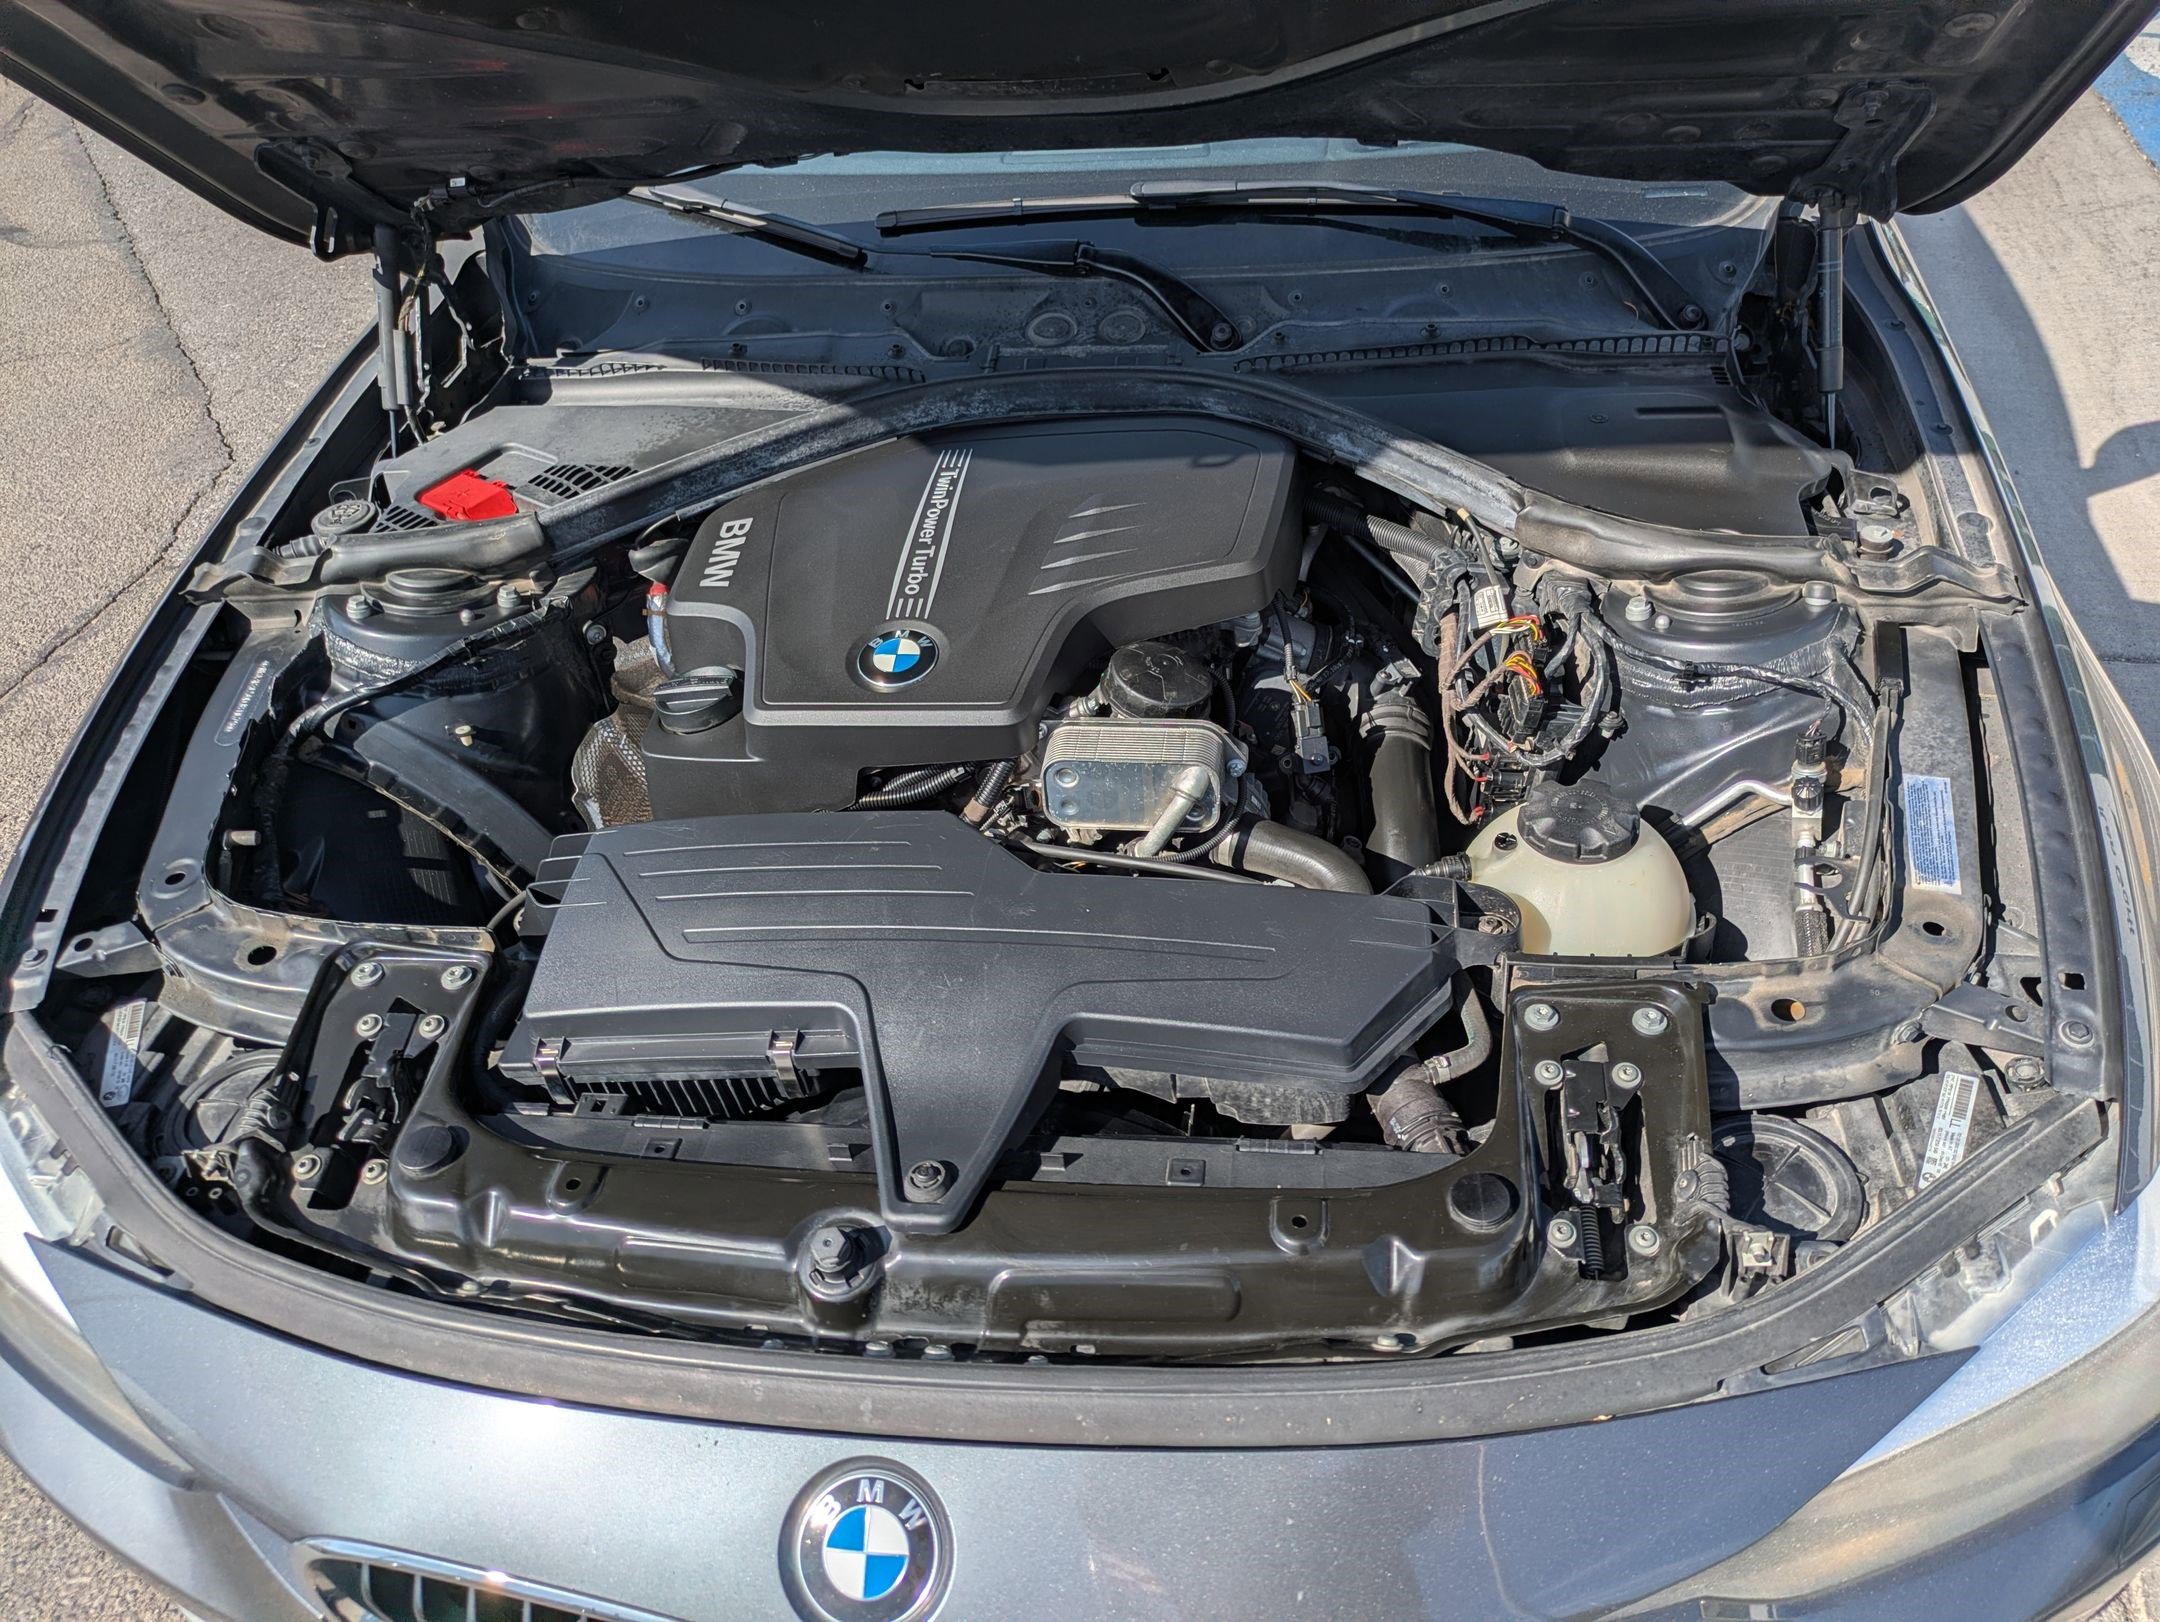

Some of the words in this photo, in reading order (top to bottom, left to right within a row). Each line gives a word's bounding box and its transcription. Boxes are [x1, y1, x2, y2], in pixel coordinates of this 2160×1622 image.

[918, 467, 958, 545] TwinPower
[699, 517, 753, 587] BMW
[904, 544, 936, 595] Turbo
[867, 628, 934, 649] BMW
[809, 1478, 928, 1532] BMW
